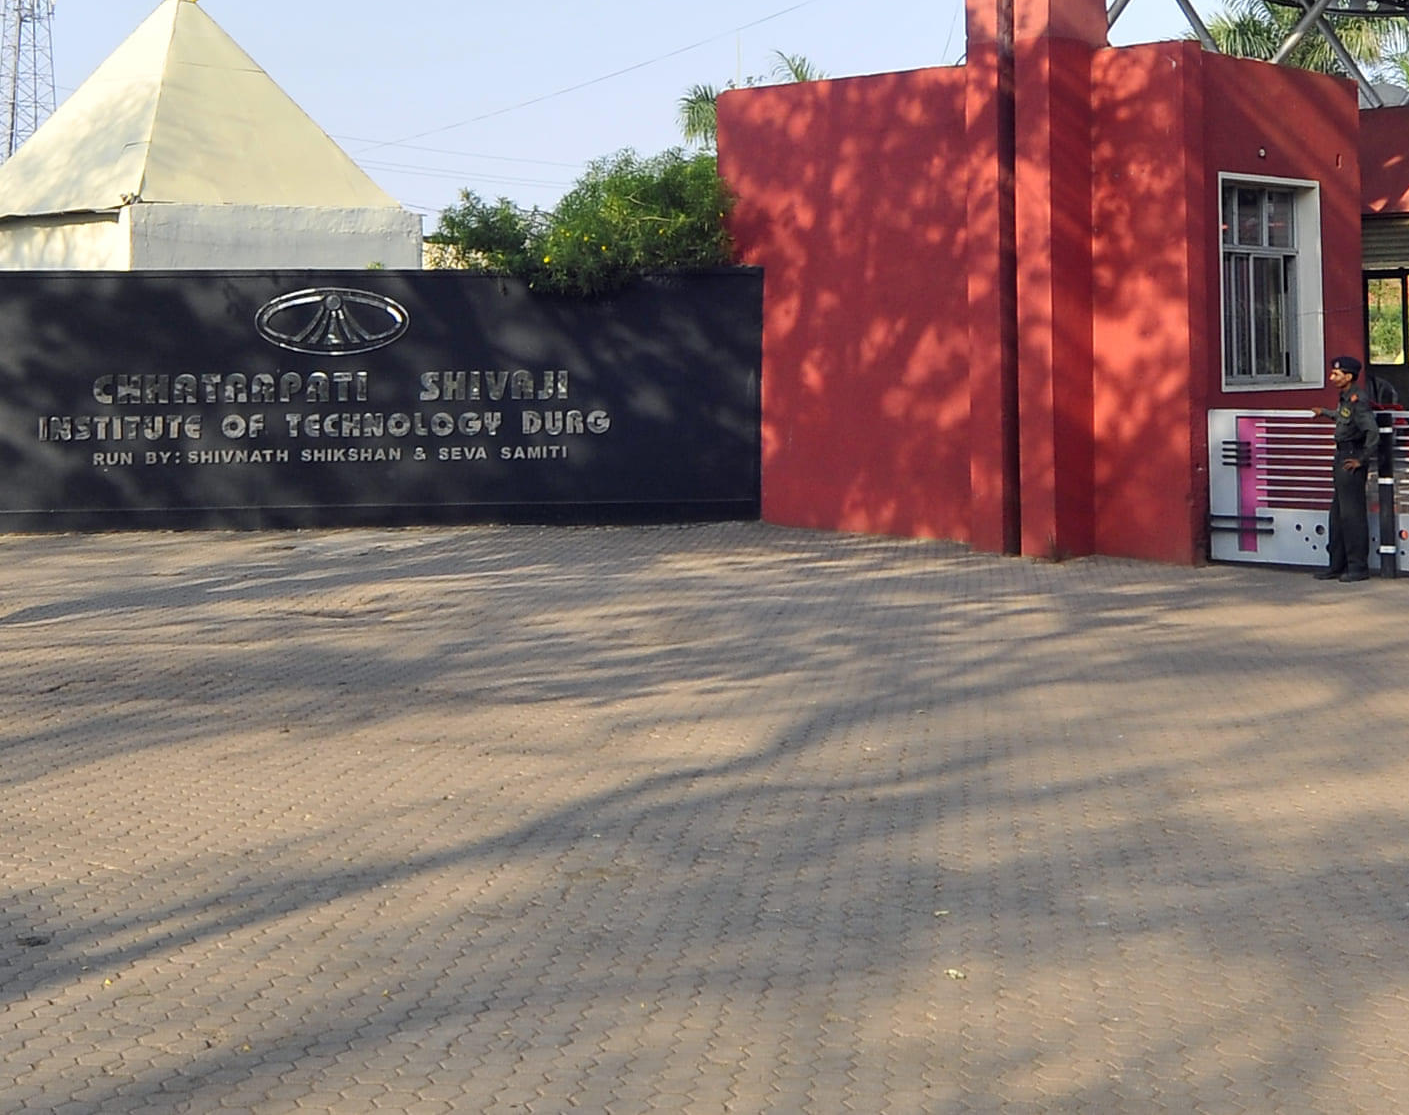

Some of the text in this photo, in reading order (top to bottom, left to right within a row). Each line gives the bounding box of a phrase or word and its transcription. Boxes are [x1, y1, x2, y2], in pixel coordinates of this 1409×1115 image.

[93, 369, 569, 404] CHHATRAPATI SHIVAJI
[38, 409, 612, 441] INSTITUTE OF TECHNOLOGY DURG
[93, 445, 568, 466] RUN BY: SHIVNATH SHIKSHAN & SEVA SAMITI
